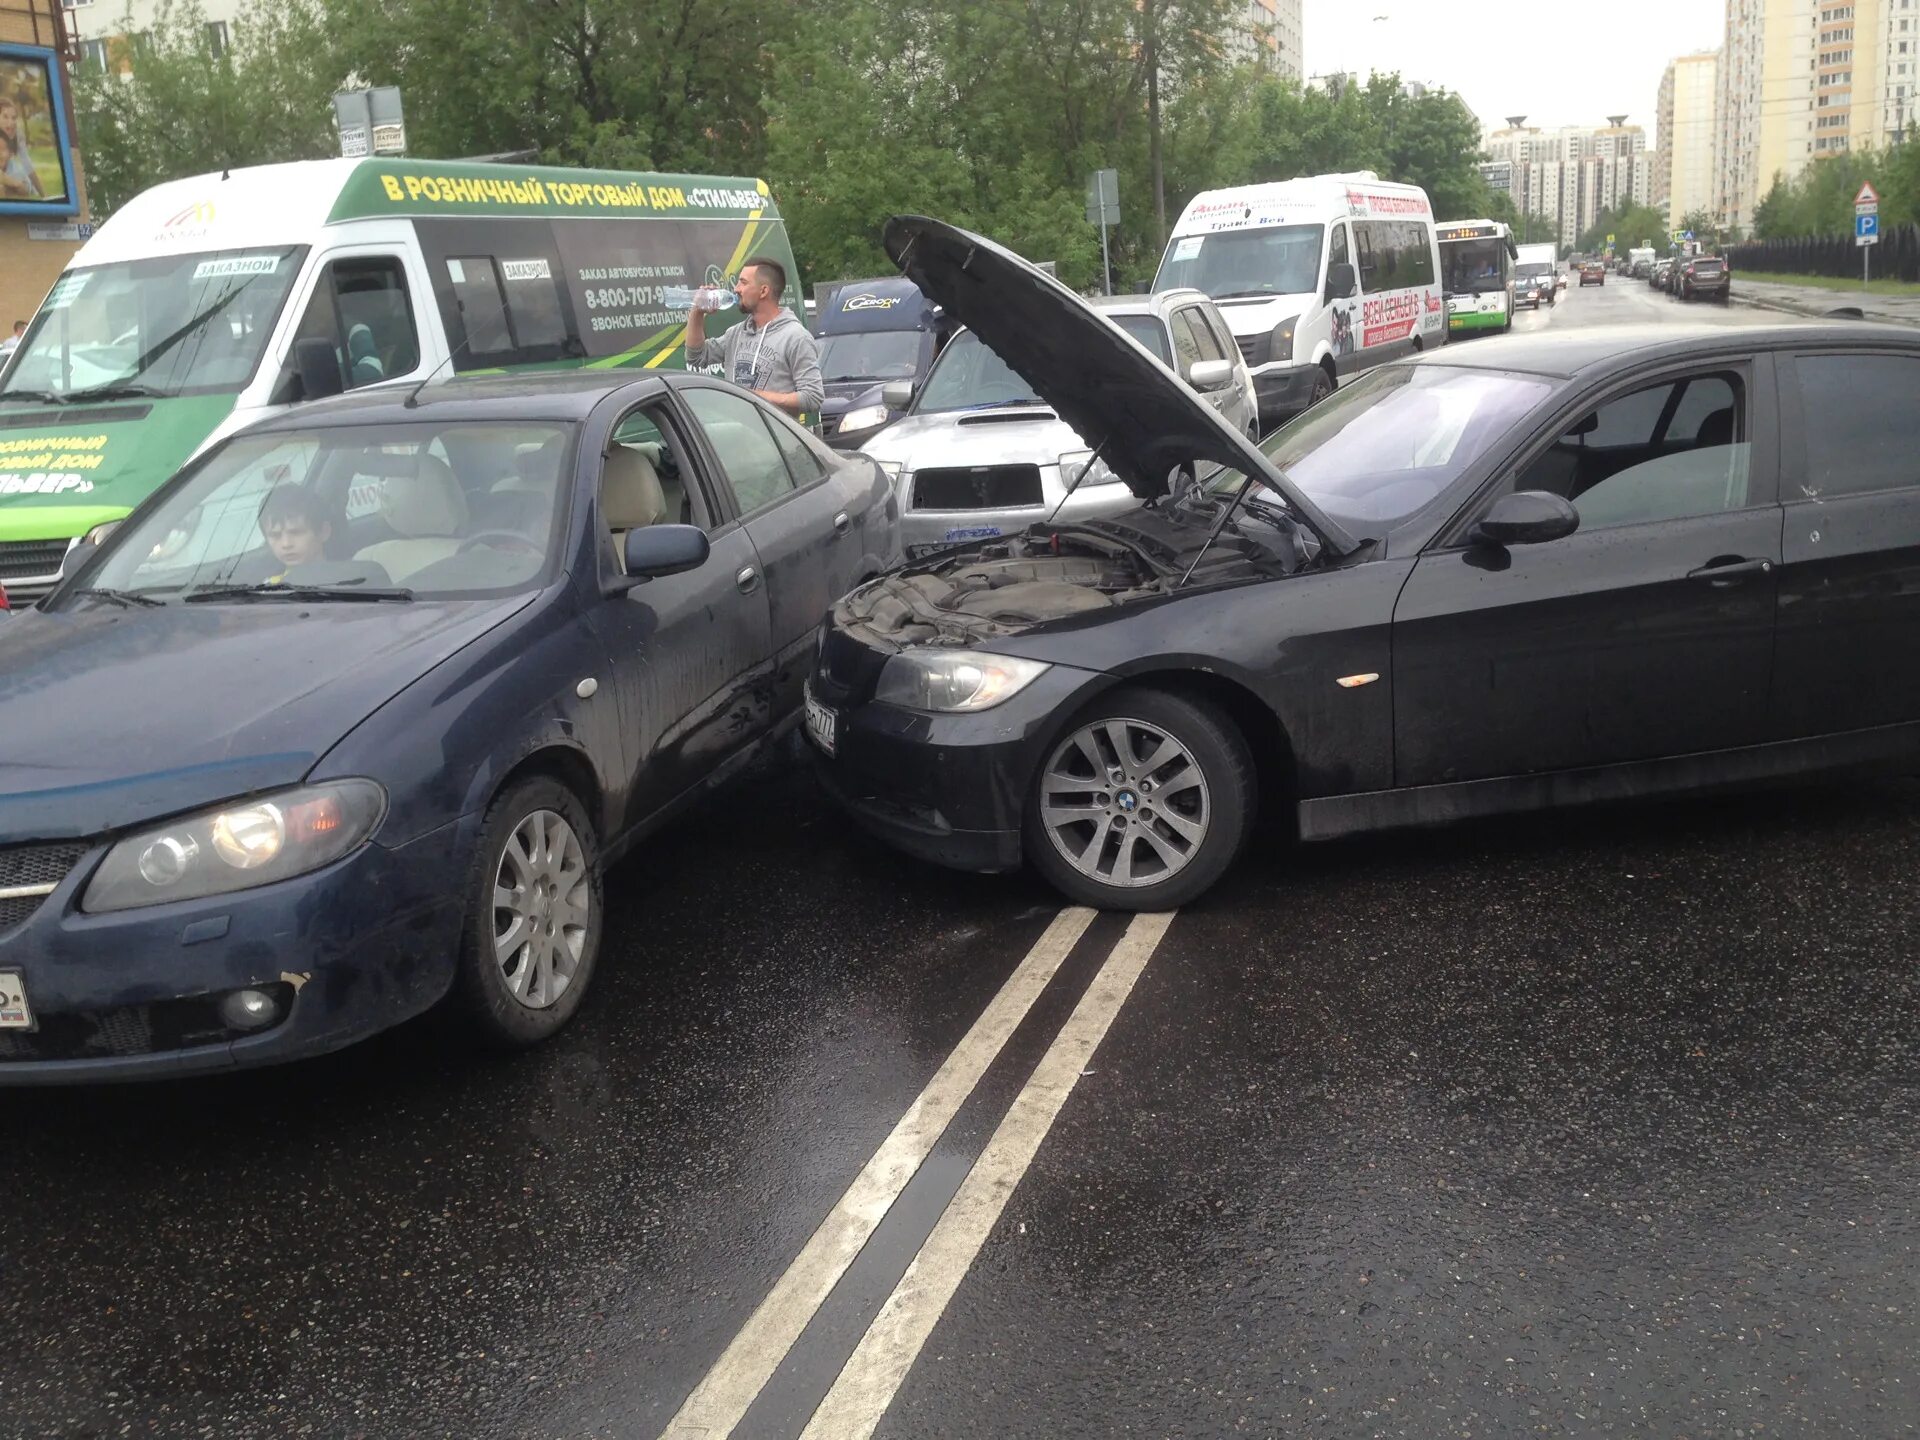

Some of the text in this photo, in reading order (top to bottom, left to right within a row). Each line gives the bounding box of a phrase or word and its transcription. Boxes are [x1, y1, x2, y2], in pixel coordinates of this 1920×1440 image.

[380, 175, 769, 211] В РОЗНИЧНЫЙ ТОРГОВЫЙ ДОМ «СТИЛЬВЕР»
[579, 268, 607, 281] ЗАКАЗ
[608, 266, 655, 280] АВТОБУСОВ
[661, 265, 686, 277] ТАКСИ
[591, 314, 633, 331] ЗВОНОК
[48, 453, 104, 470] ДОМ
